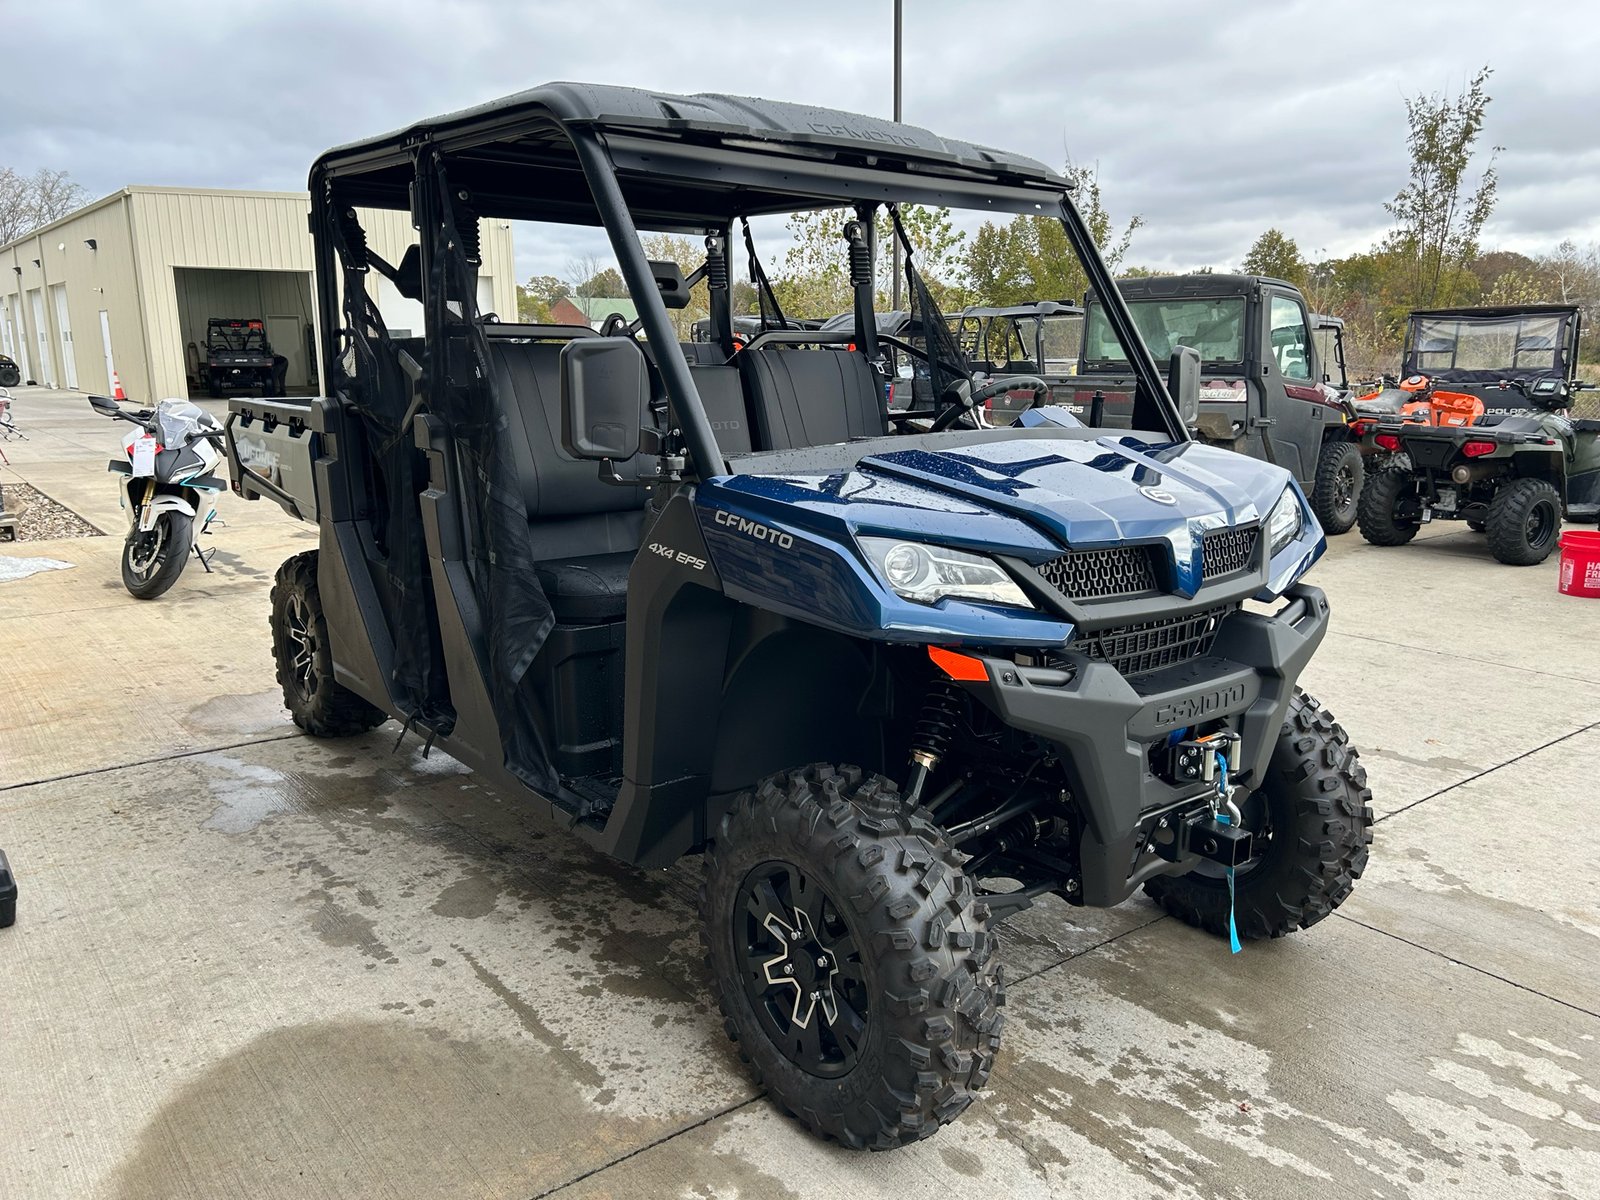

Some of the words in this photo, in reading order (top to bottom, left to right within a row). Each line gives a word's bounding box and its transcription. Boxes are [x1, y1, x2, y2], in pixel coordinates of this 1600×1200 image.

[807, 122, 919, 147] CFMOTO
[1044, 404, 1084, 414] ARIS
[1486, 407, 1538, 416] POLAR
[711, 420, 740, 431] OTO
[715, 509, 793, 549] CFMOTO
[648, 542, 675, 559] 4X4
[675, 551, 707, 570] EPS
[1154, 683, 1245, 727] CFMOTO
